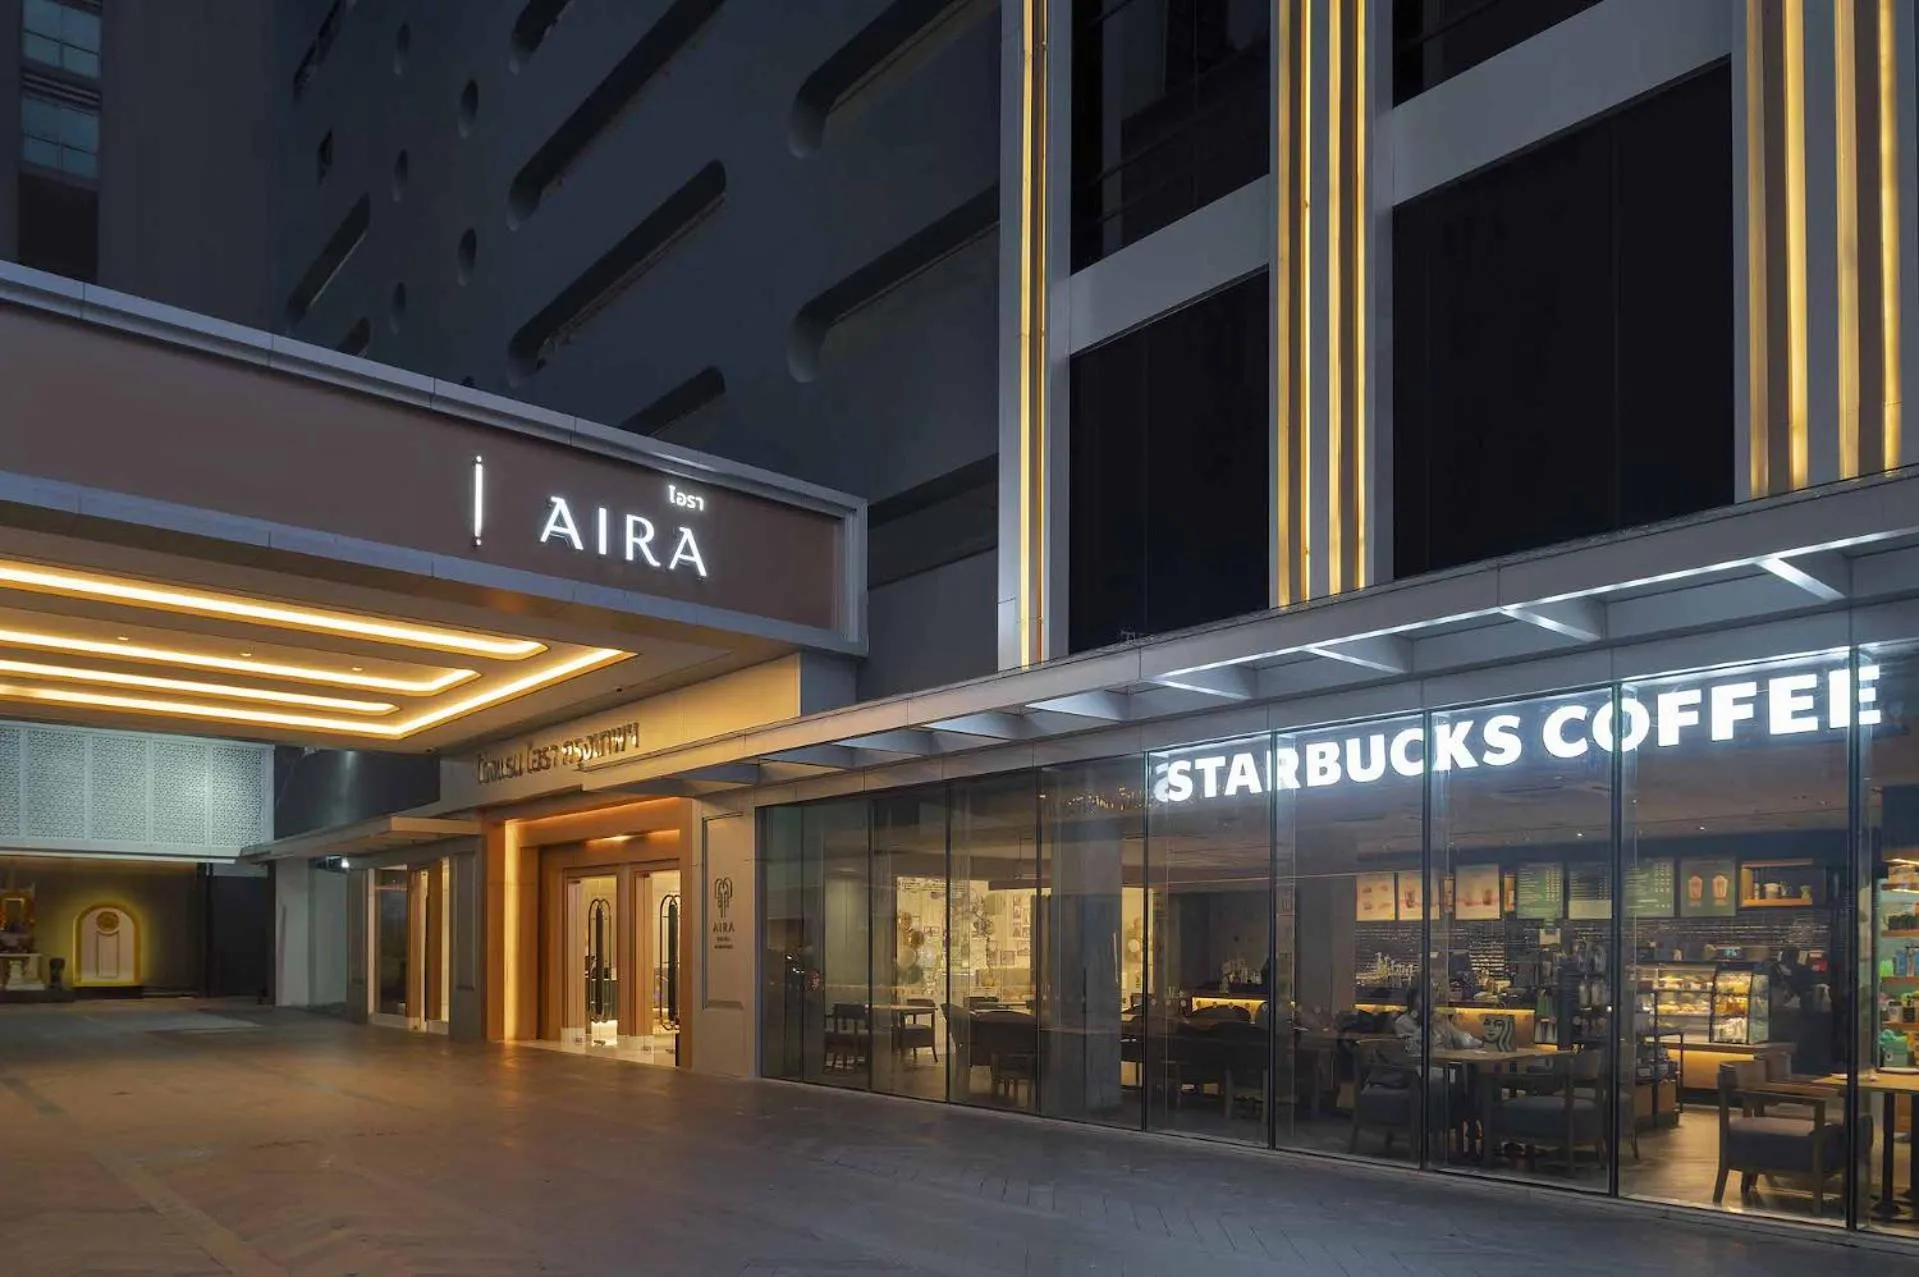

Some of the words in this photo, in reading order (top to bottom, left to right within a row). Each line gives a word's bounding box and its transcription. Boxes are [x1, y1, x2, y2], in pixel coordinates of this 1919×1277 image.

[539, 496, 708, 578] AIRA
[668, 484, 705, 512] ไอรา
[1167, 713, 1523, 803] STARBUCKS
[1542, 664, 1881, 755] COFFEE
